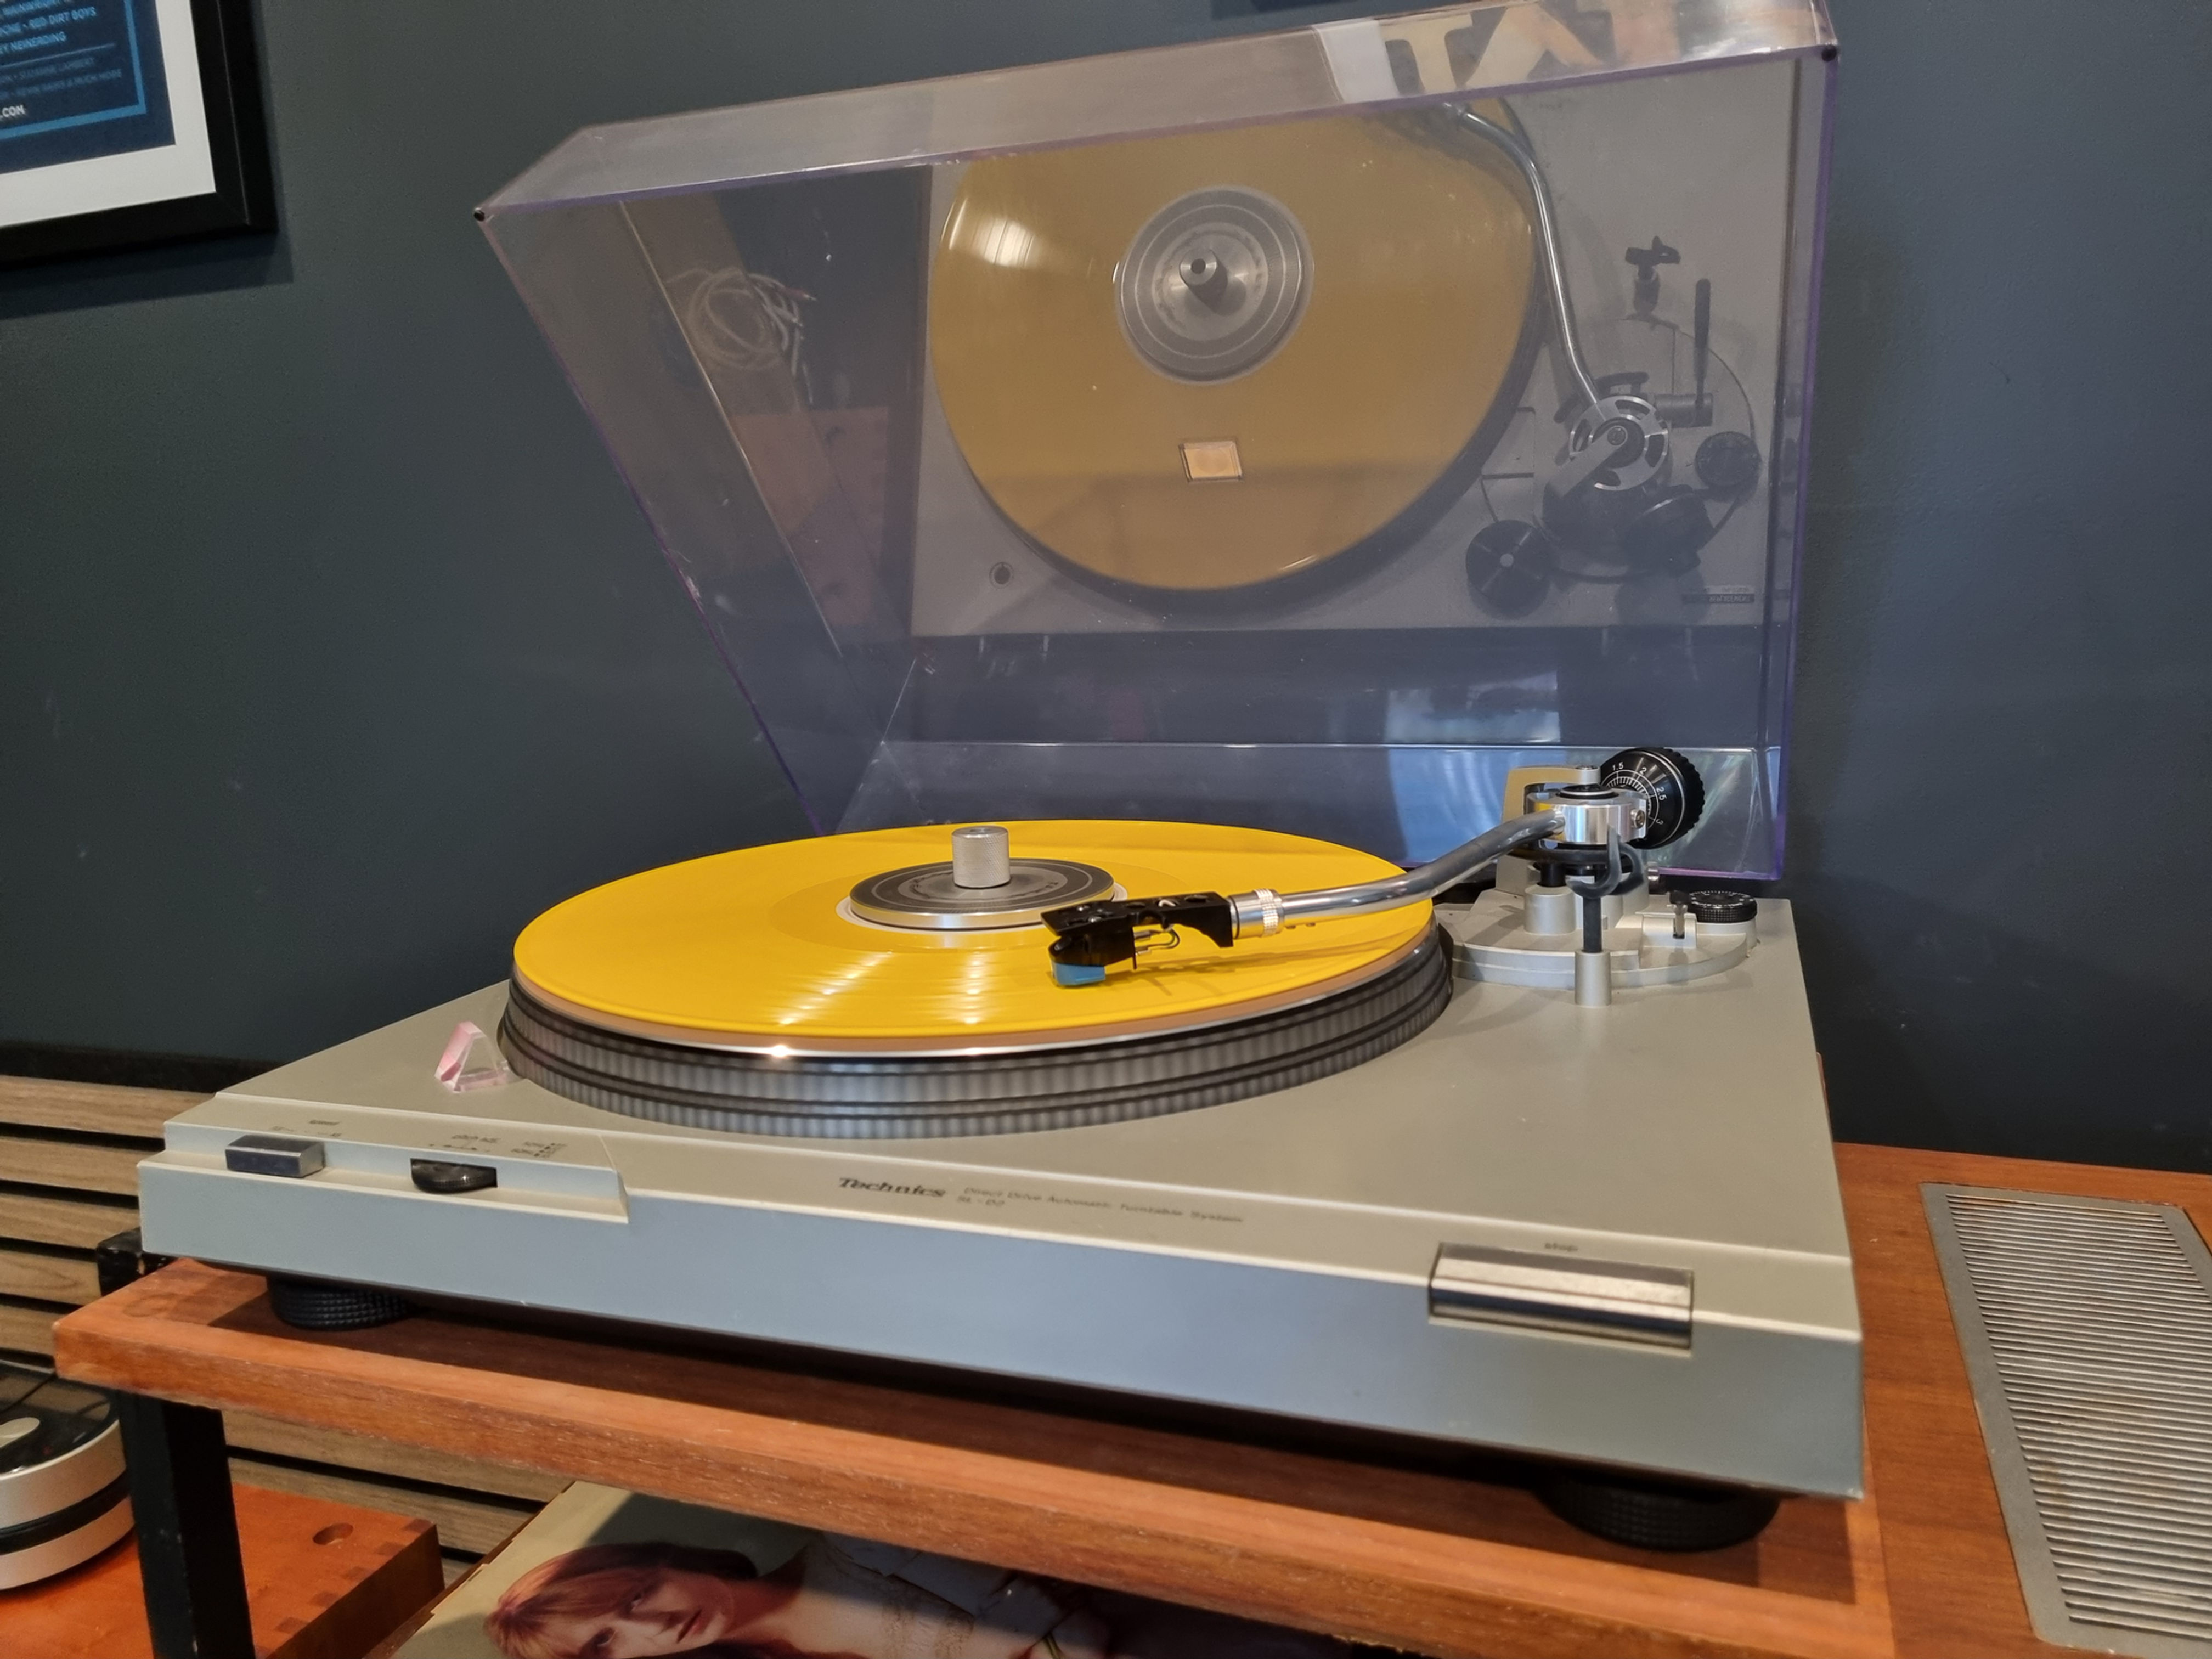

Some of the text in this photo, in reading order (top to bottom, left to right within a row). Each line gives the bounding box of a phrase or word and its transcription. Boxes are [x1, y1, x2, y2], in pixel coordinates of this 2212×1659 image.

[1612, 761, 1624, 771] 1.5
[1640, 766, 1647, 776] 2
[1656, 786, 1668, 802] 2.5
[839, 1177, 946, 1198] Technics
